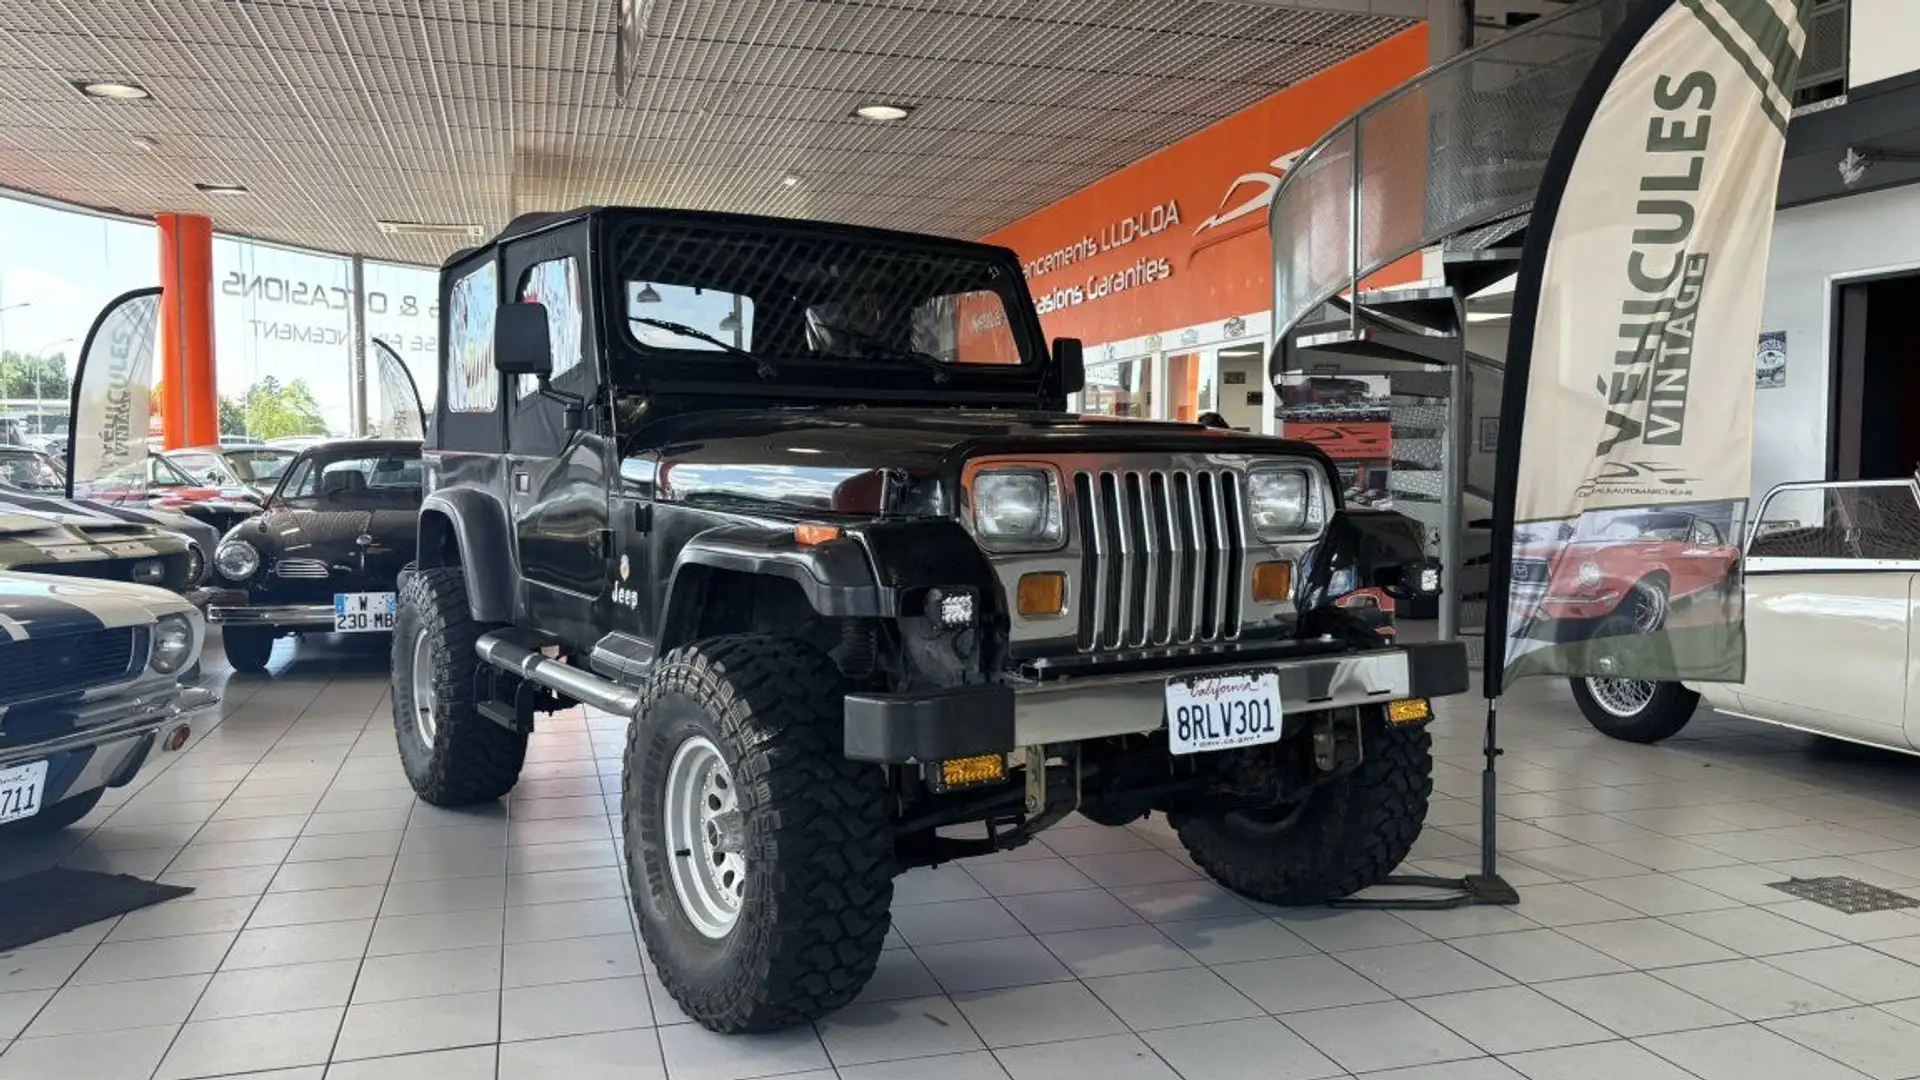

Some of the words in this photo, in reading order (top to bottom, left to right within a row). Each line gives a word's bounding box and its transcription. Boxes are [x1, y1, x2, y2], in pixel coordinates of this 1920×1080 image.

[1022, 235, 1098, 280] ancements
[1100, 199, 1180, 251] LLD-LOA
[1596, 70, 1717, 457] VÉHICULES
[1034, 285, 1084, 315] asions
[1087, 257, 1171, 300] Garanties
[1646, 257, 1707, 440] VINTAGE
[358, 595, 368, 611] W
[611, 579, 638, 610] Jeep
[1190, 677, 1259, 701] California
[1177, 698, 1275, 742] 8RLV301
[1, 783, 36, 816] 711
